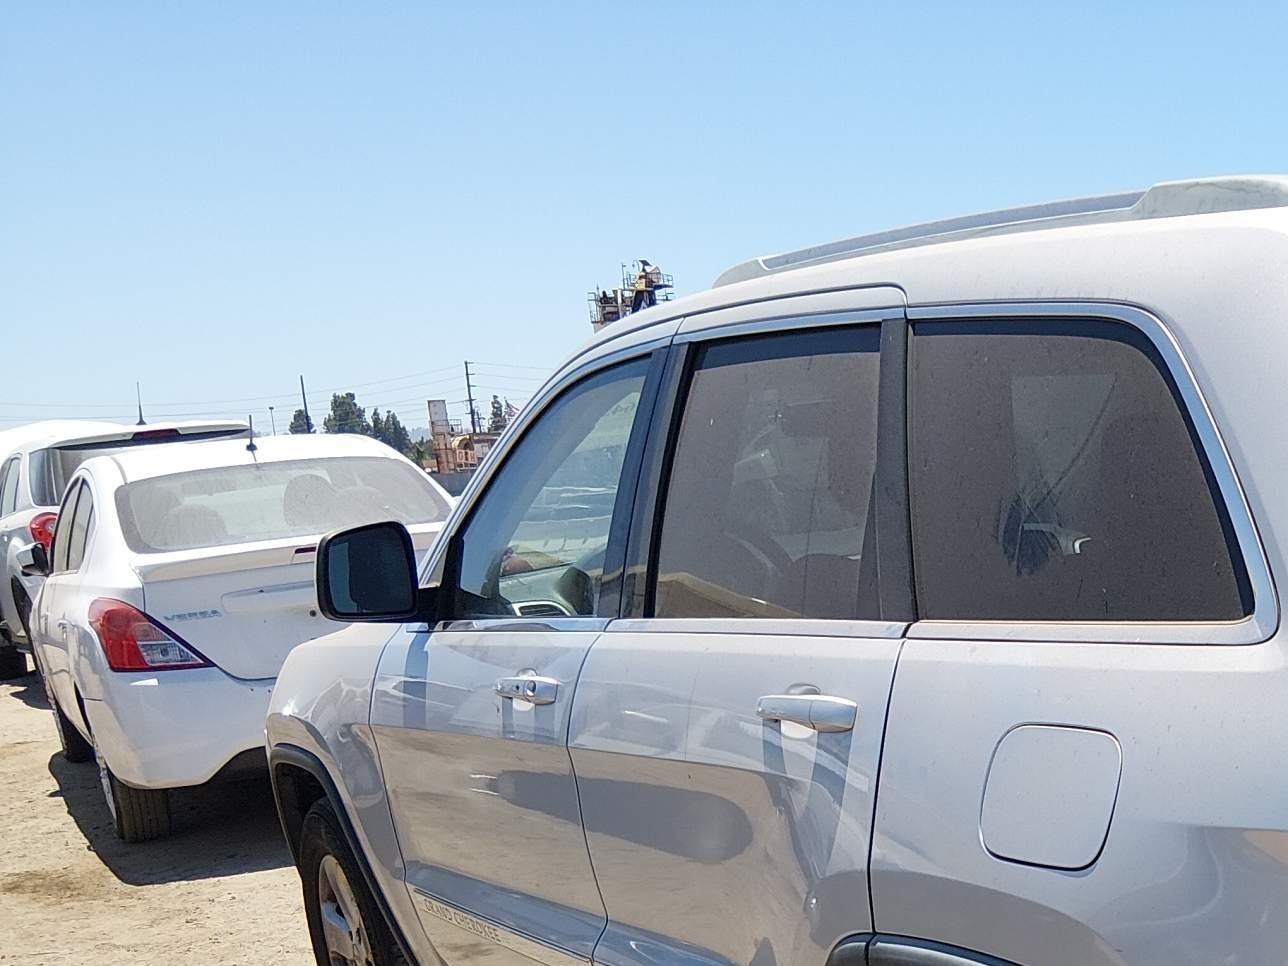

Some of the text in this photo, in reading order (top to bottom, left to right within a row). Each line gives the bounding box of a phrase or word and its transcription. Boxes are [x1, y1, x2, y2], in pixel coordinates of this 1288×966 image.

[163, 609, 222, 621] VERSA
[424, 899, 502, 943] GRAND CHEROKEE
